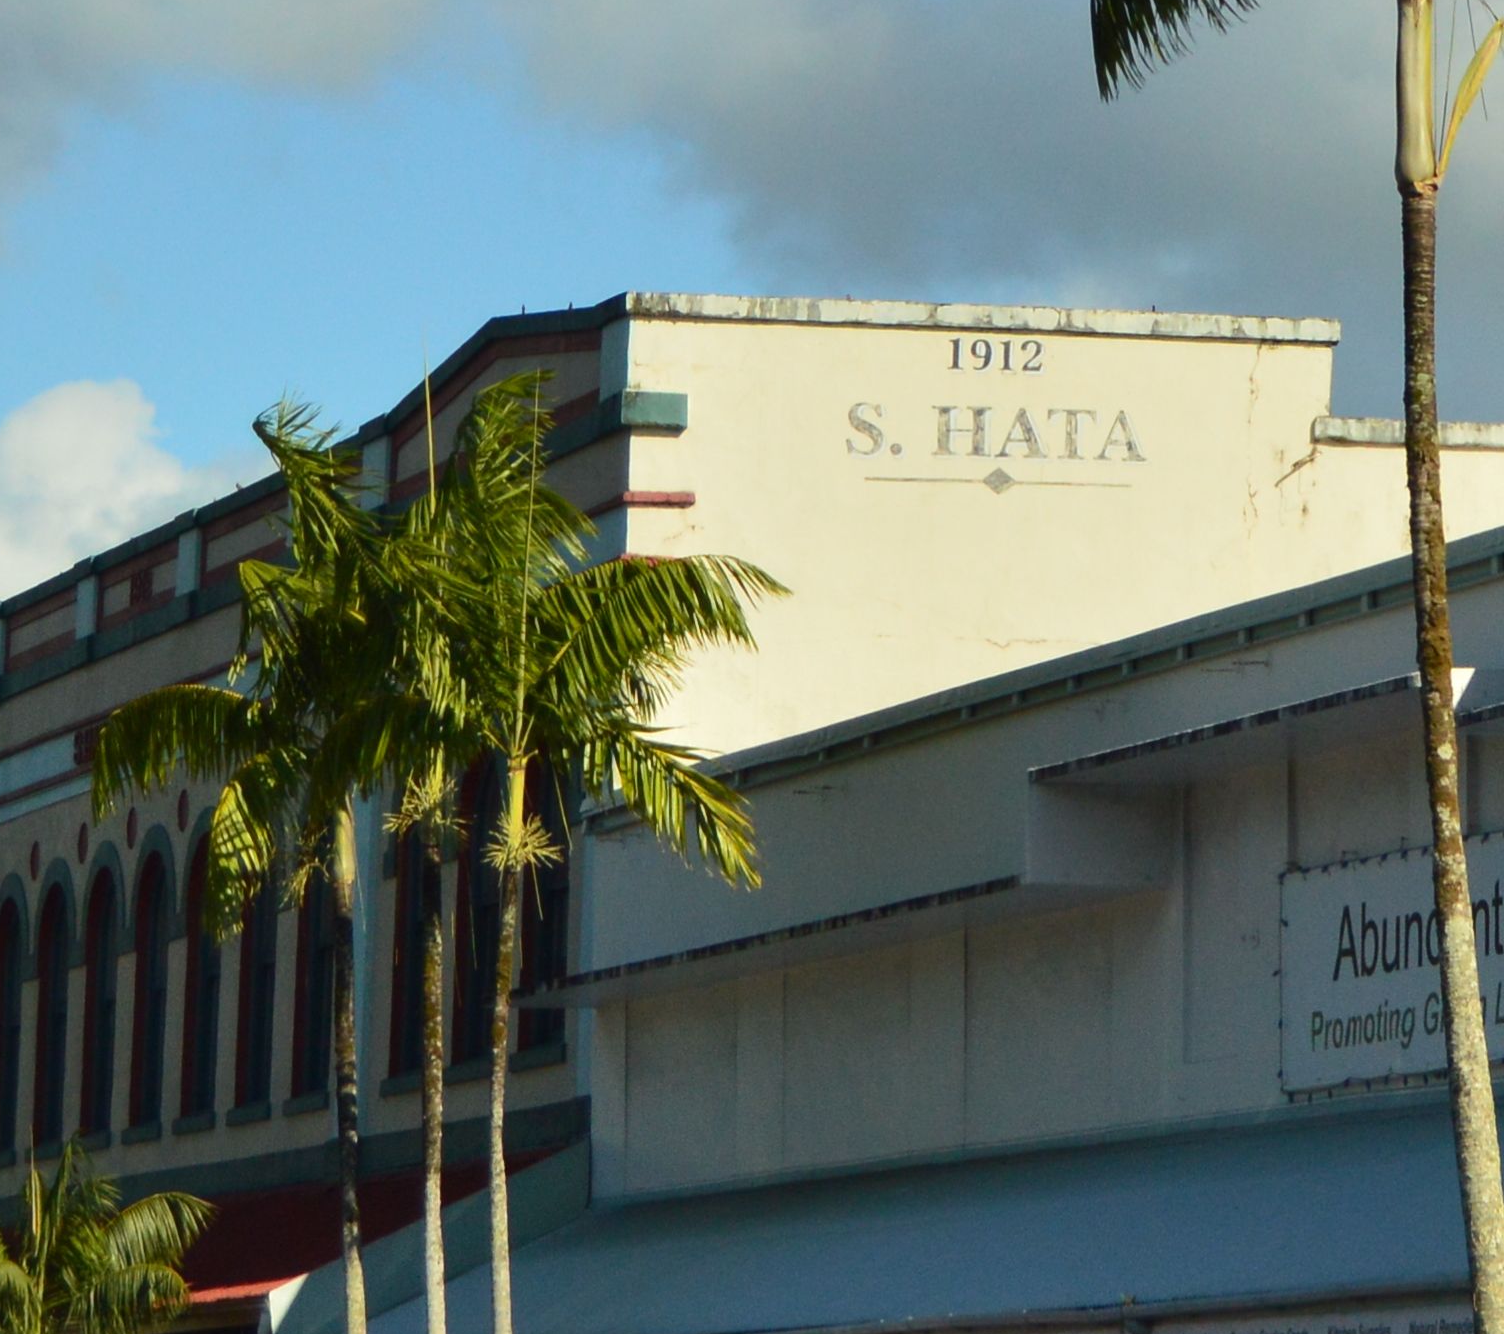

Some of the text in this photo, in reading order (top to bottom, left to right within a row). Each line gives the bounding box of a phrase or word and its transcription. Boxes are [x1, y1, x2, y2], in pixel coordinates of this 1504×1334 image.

[947, 337, 1044, 374] 1912
[846, 402, 1148, 462] S. HATA
[1333, 878, 1504, 982] Abunnt
[1311, 1000, 1416, 1052] Promoting
[1439, 1317, 1474, 1334] Remedie
